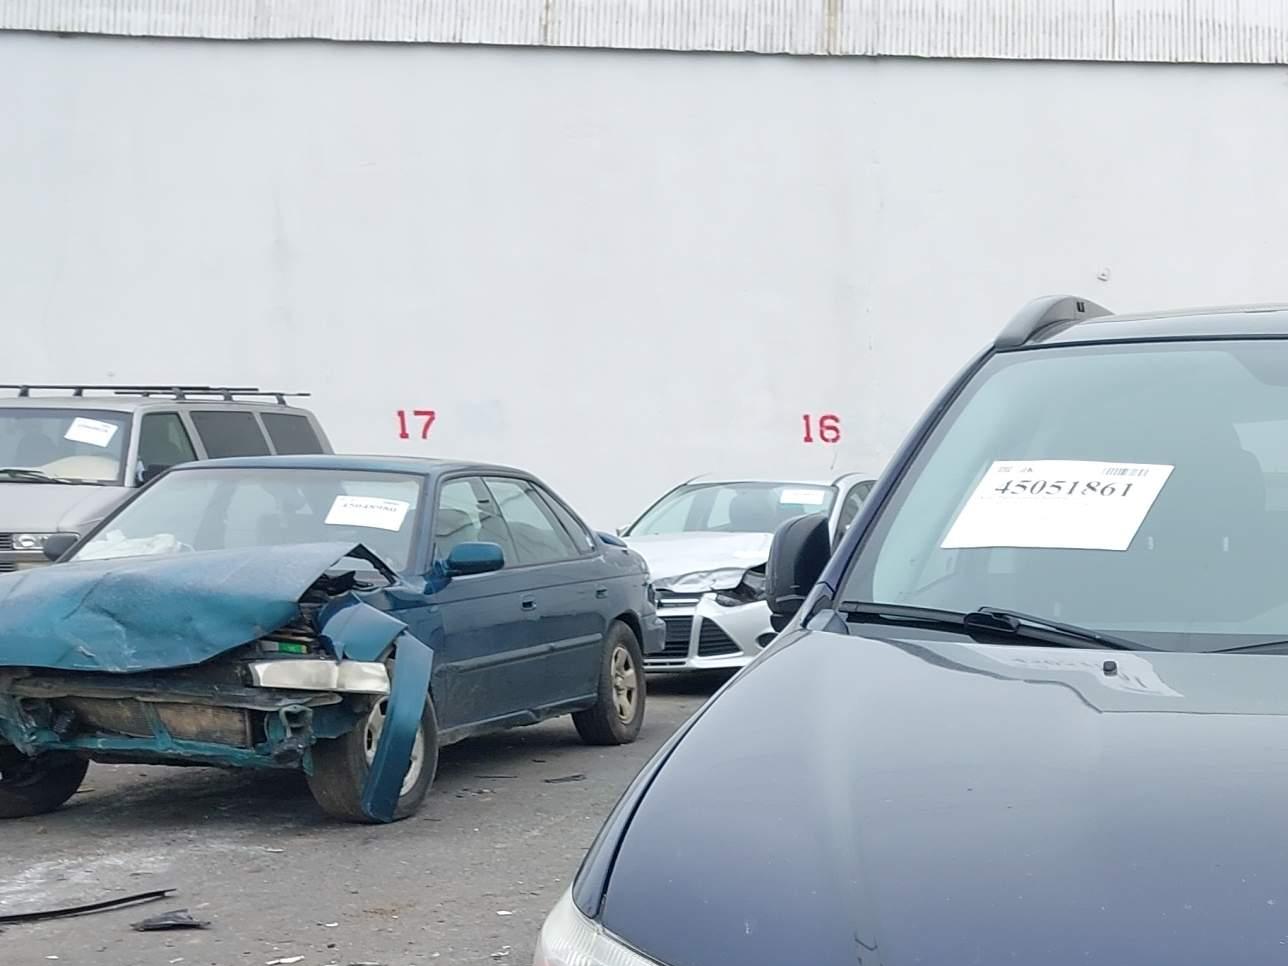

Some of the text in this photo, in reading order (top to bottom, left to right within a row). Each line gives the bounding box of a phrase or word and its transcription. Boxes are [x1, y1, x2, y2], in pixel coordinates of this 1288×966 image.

[397, 410, 437, 440] 17
[802, 414, 841, 444] 16
[994, 479, 1134, 498] 45051861
